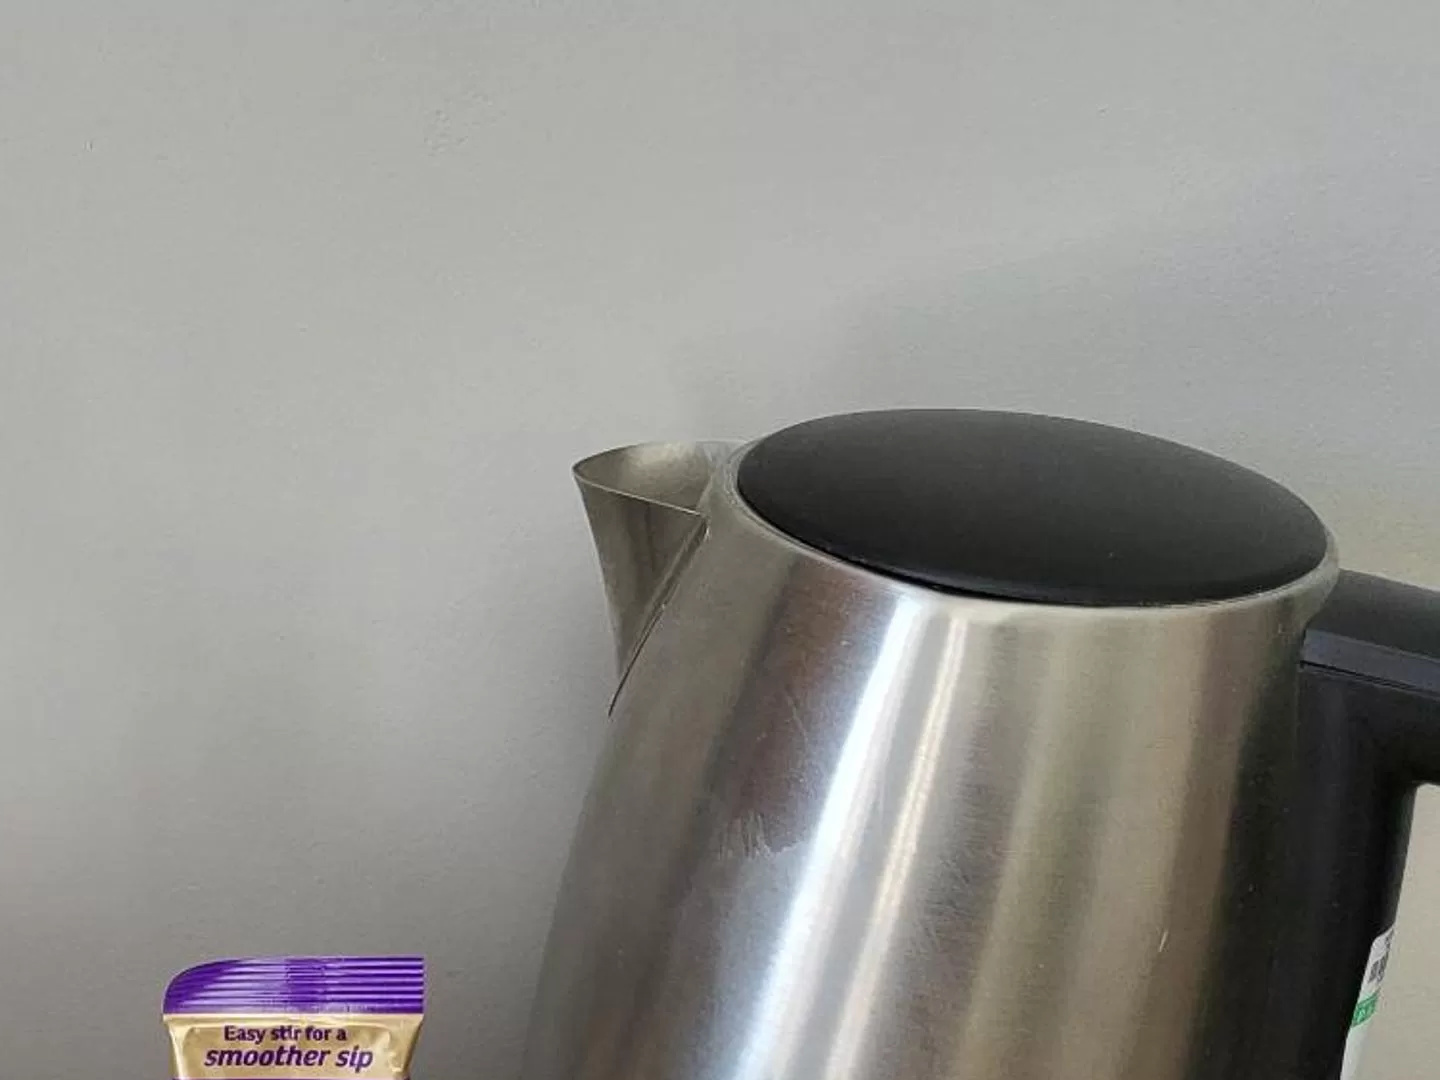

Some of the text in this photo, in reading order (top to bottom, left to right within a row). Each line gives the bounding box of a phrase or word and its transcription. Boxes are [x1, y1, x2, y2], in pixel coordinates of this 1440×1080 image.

[224, 1025, 348, 1044] Easy stir for a
[204, 1046, 375, 1073] smoother sip
